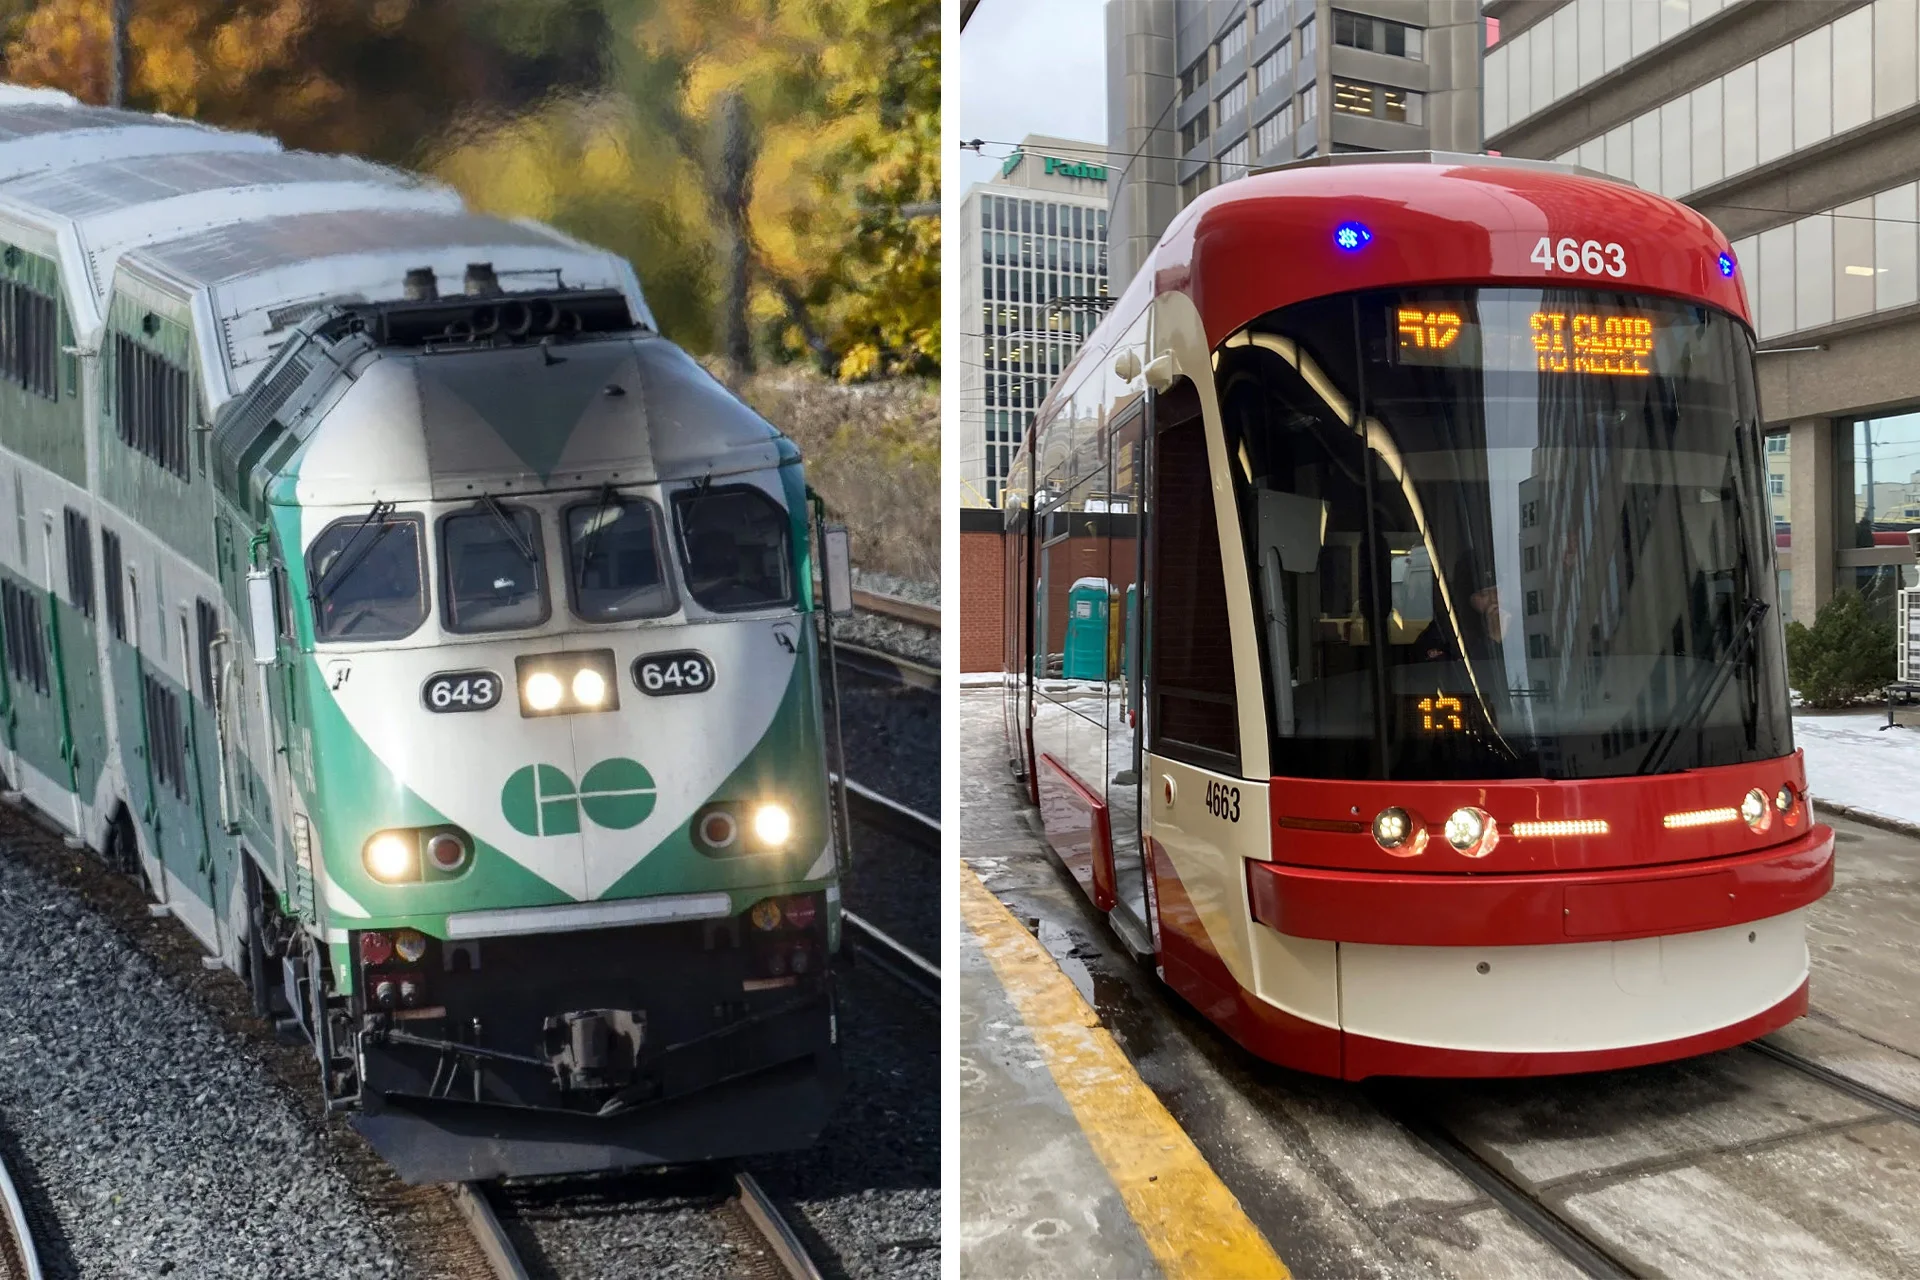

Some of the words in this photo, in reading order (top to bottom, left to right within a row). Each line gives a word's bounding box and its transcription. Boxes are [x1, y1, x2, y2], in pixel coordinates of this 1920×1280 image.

[1530, 236, 1627, 277] 4663
[1398, 310, 1461, 348] 512
[641, 659, 705, 689] 643
[431, 677, 493, 707] 643
[1418, 697, 1462, 730] 13
[1205, 779, 1241, 823] 4663
